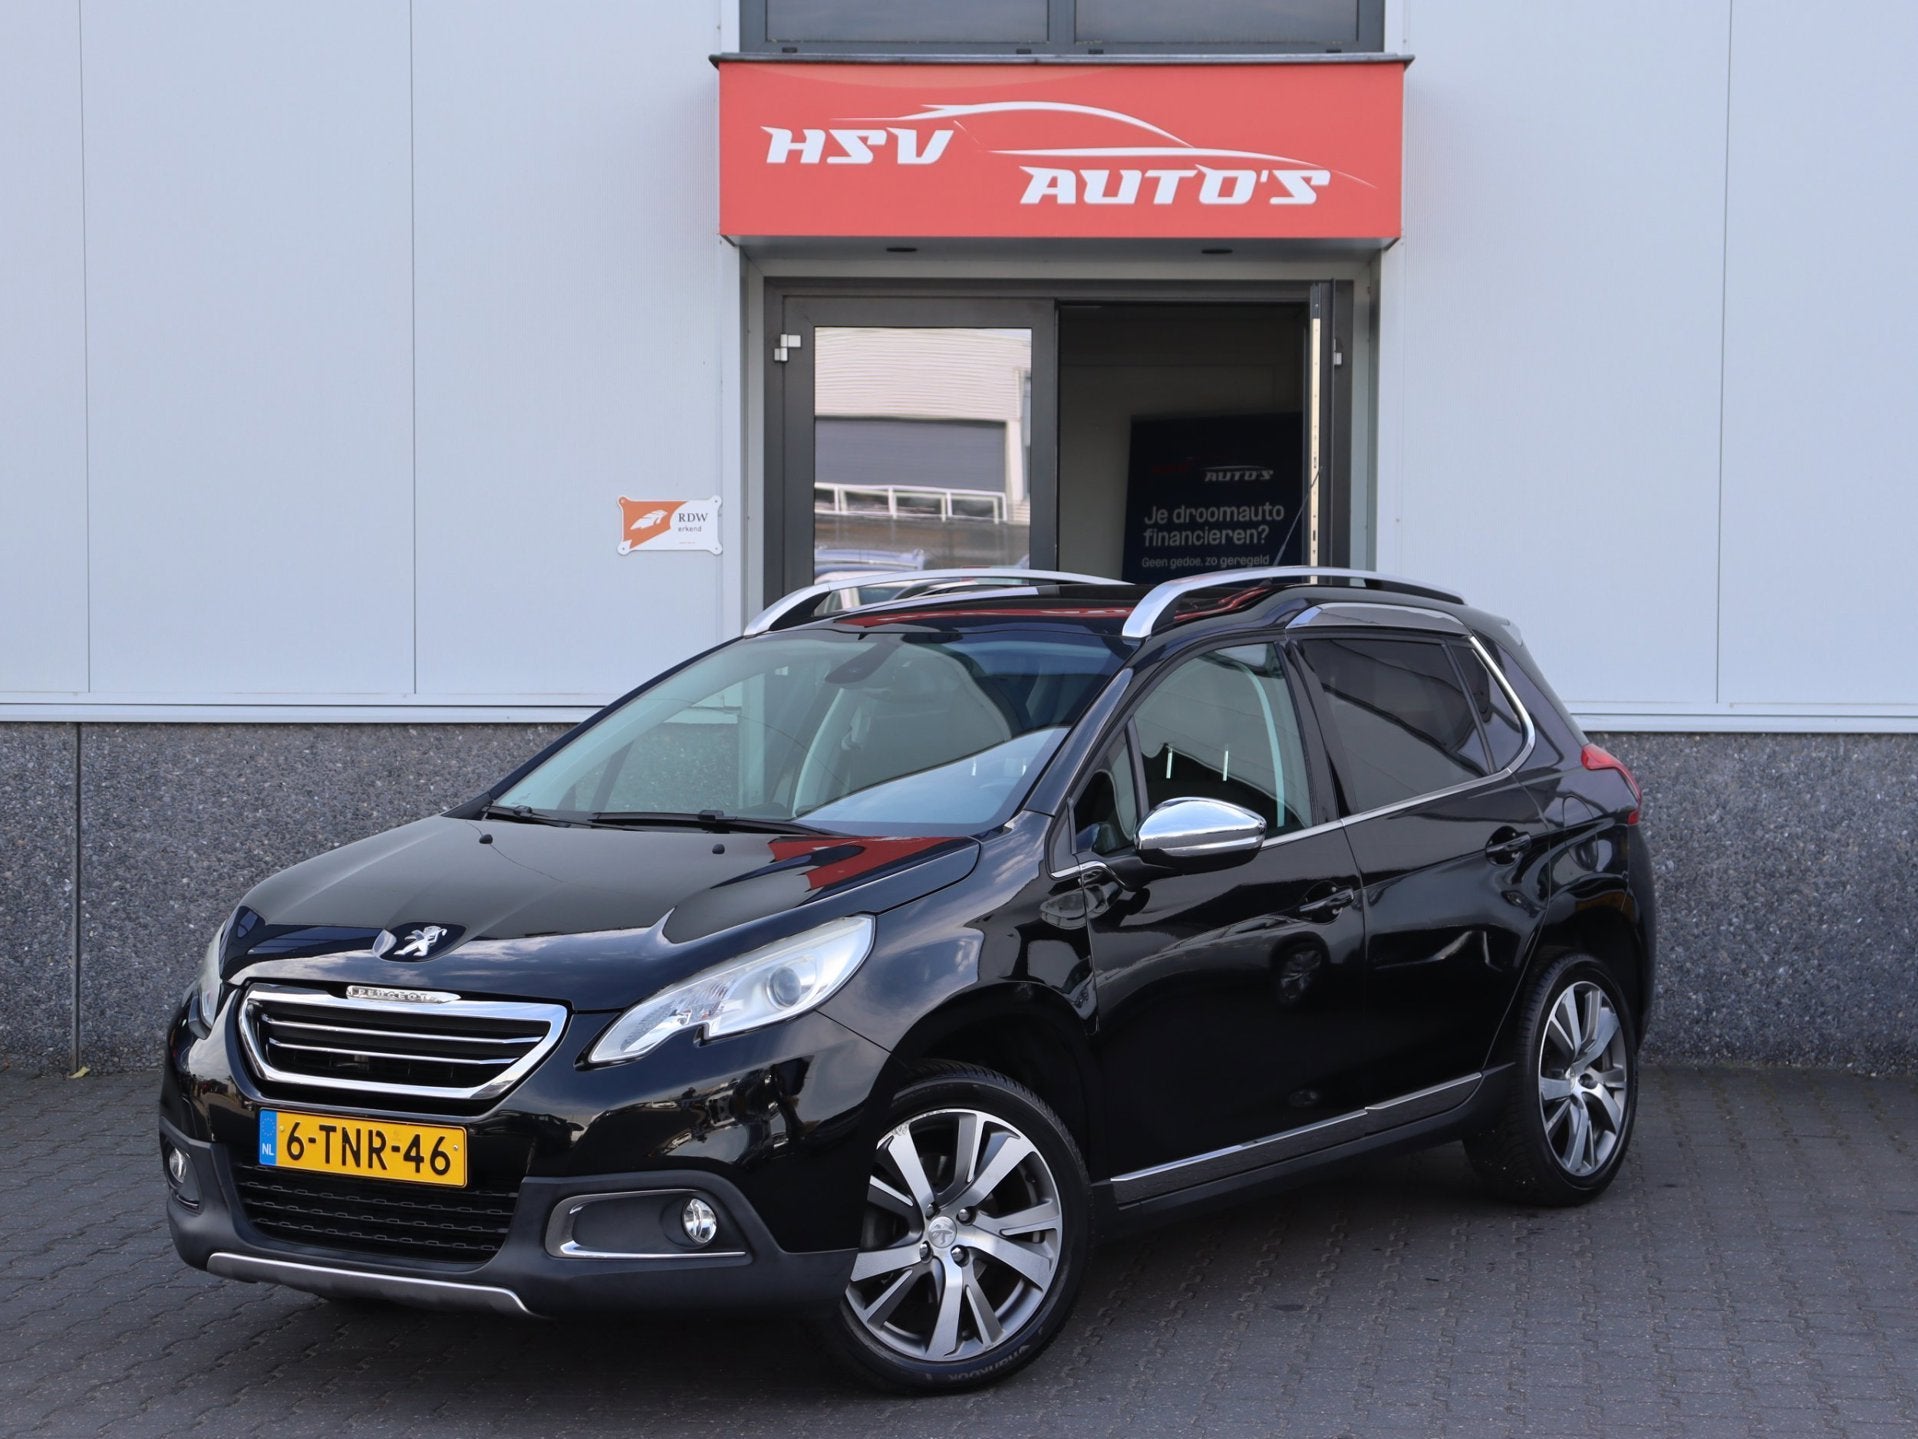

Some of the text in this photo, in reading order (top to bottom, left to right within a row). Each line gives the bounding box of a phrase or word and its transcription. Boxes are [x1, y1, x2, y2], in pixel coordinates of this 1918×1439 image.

[761, 125, 954, 165] HSV
[1018, 163, 1331, 205] AUTO'S
[1204, 470, 1274, 482] AUTO'S
[678, 513, 708, 522] RDW
[1144, 502, 1285, 525] Je droomauto
[1143, 525, 1270, 547] financieren?
[1141, 556, 1168, 568] Geen
[1205, 557, 1218, 566] zo
[1220, 554, 1270, 569] geregeld
[262, 1143, 275, 1156] NL
[286, 1121, 451, 1176] 6-TNR-46
